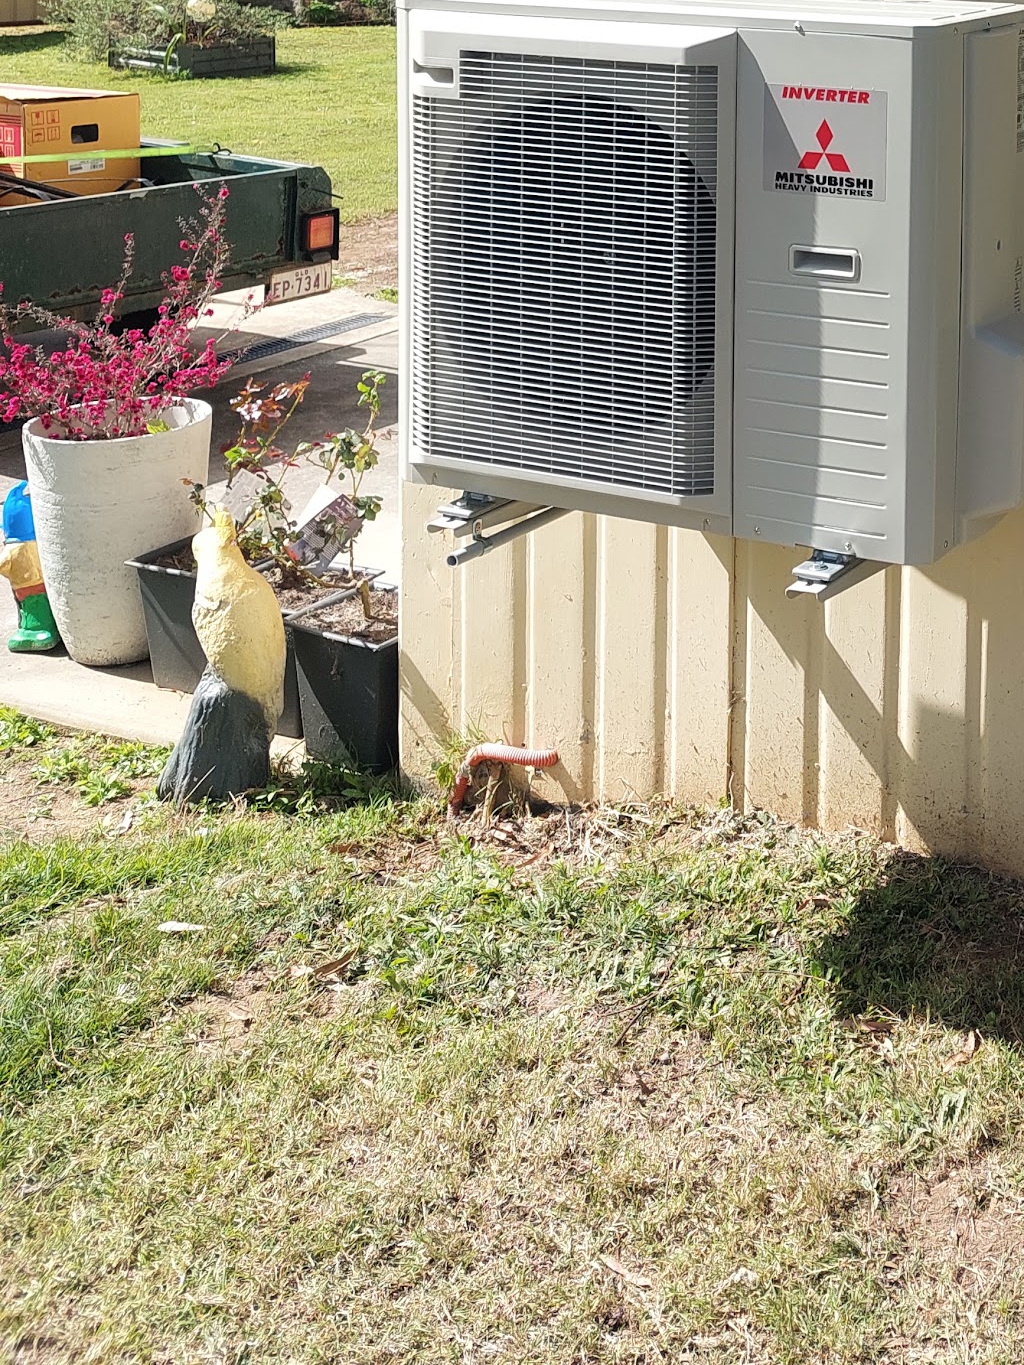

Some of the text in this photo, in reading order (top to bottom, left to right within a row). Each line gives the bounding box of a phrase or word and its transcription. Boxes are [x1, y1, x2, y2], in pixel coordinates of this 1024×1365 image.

[781, 86, 870, 104] INVERTER
[775, 171, 873, 189] MITSUBISHI
[775, 182, 873, 197] HEAVY INDUSTRIES
